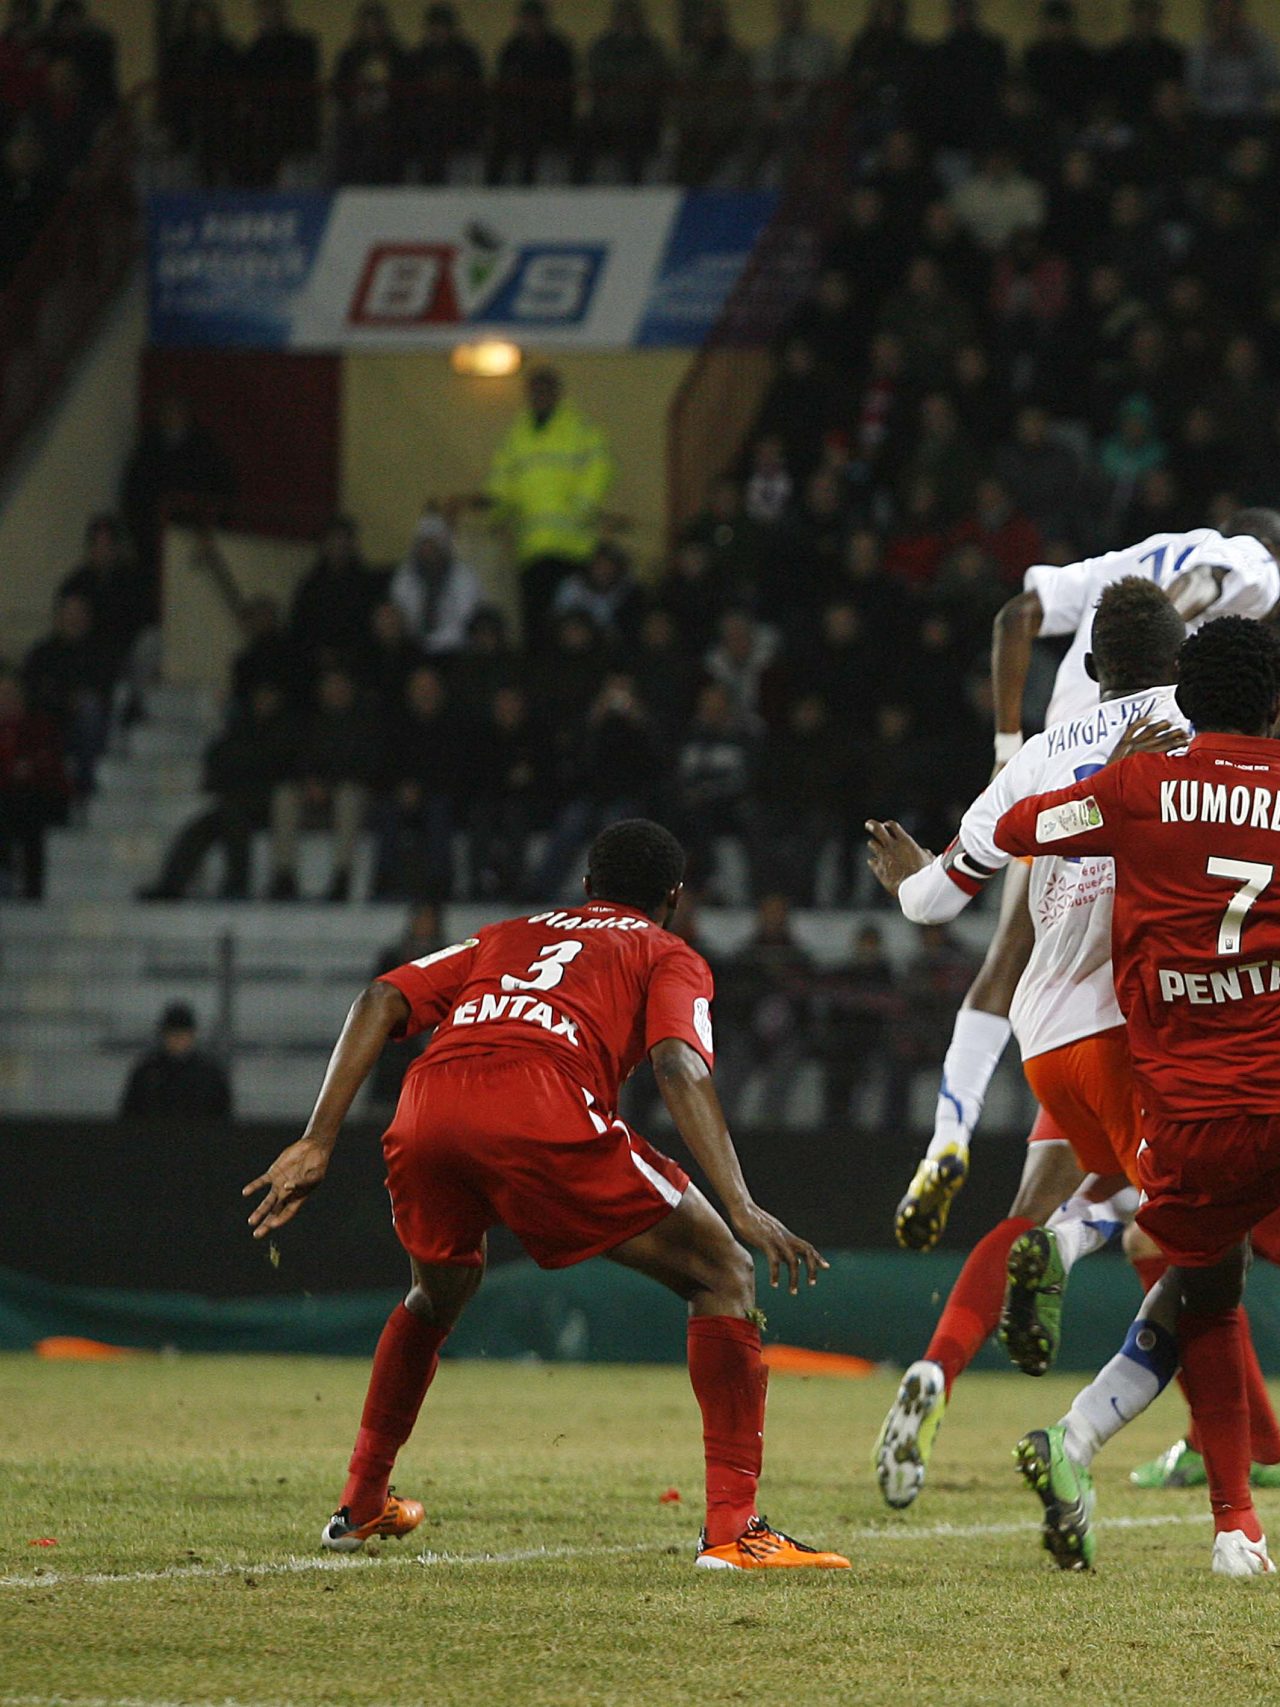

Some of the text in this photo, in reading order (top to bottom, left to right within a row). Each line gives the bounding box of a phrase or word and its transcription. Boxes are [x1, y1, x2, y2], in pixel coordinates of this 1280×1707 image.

[362, 246, 593, 318] BVS
[1206, 855, 1275, 955] 7
[500, 938, 584, 992] 3
[434, 993, 579, 1047] ENTAX
